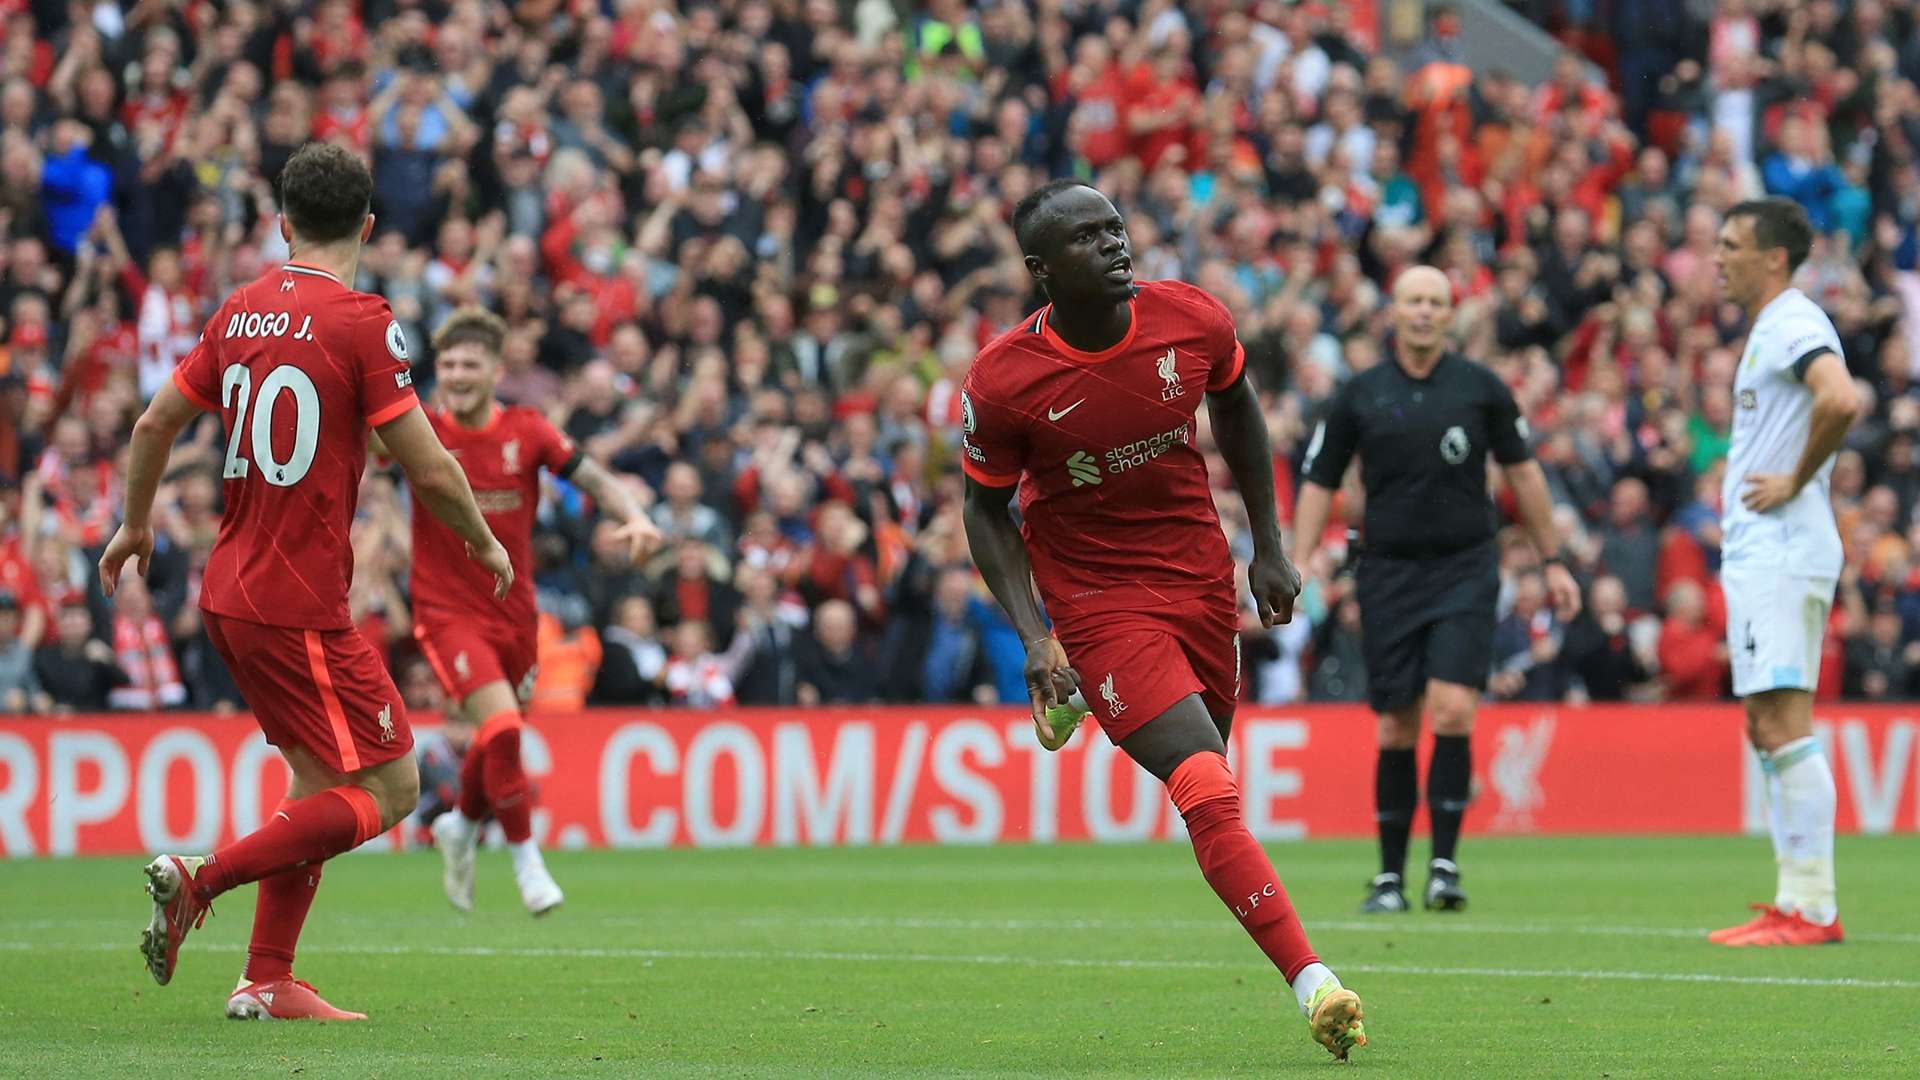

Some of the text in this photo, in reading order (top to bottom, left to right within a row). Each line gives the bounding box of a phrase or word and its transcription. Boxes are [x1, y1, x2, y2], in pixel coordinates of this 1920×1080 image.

[225, 312, 314, 342] DIOGO J.
[222, 363, 320, 487] 20
[1745, 619, 1756, 657] 4
